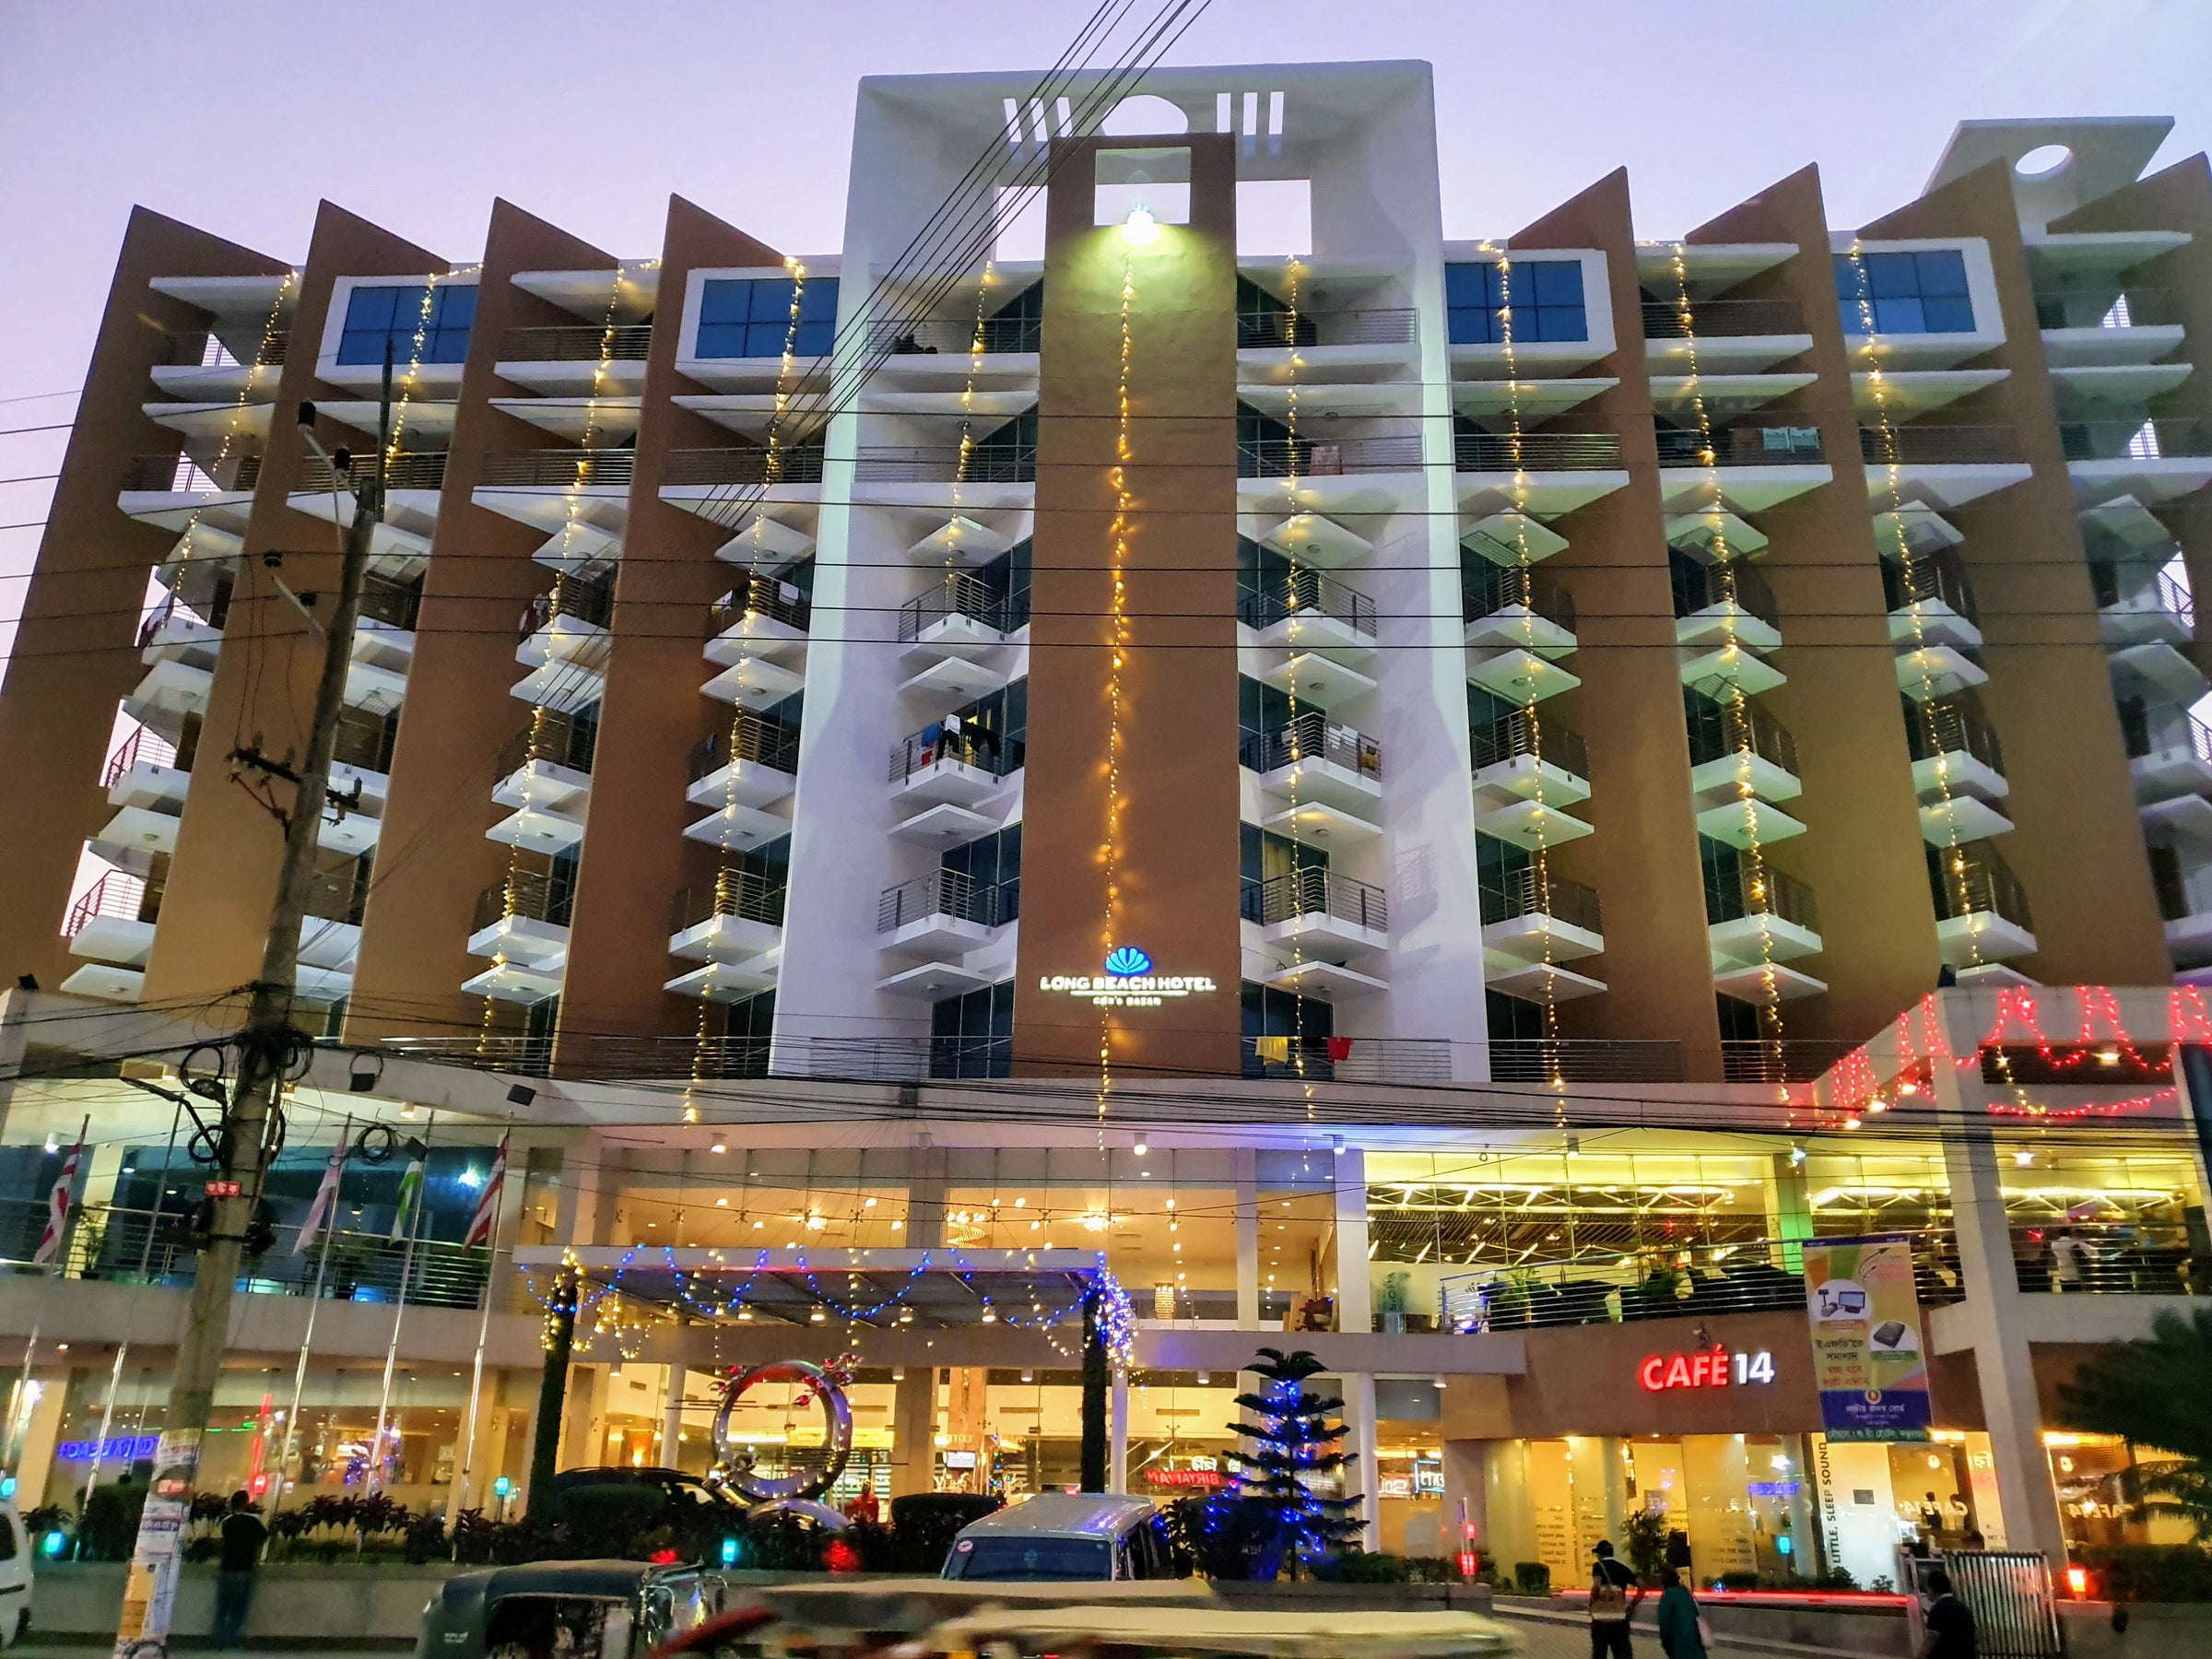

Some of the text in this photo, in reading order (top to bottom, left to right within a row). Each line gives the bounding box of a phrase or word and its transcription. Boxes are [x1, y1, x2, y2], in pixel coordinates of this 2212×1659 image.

[1040, 975, 1217, 992] LONG BEACH HOTEL
[1641, 1343, 1775, 1391] CAFÉ 14
[1818, 1442, 1841, 1564] LITTLE, SLEEP SOUND
